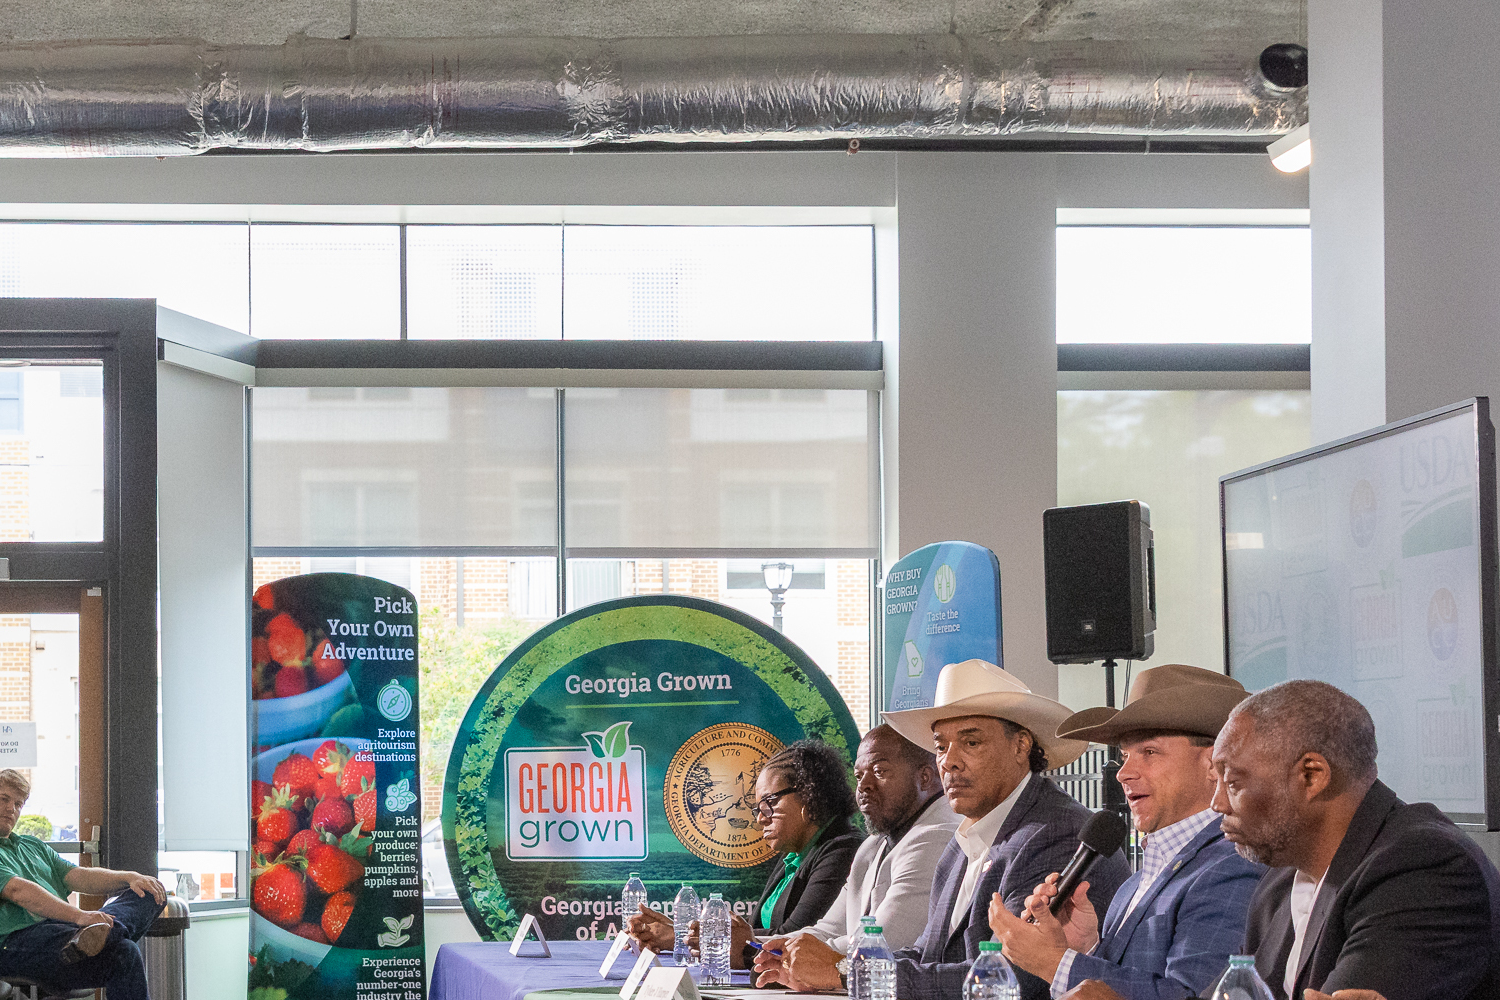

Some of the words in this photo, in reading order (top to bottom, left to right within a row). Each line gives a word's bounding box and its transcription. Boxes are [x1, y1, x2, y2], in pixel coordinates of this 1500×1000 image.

[1399, 433, 1471, 493] USDA
[887, 571, 905, 583] WHY
[906, 568, 921, 580] BUY
[887, 585, 918, 599] GEORGIA
[374, 597, 414, 614] Pick
[886, 601, 918, 614] GROWN?
[927, 611, 946, 622] Taste
[947, 608, 959, 619] the
[327, 619, 369, 637] Your
[374, 621, 414, 637] Own
[926, 622, 960, 635] difference
[321, 643, 415, 661] Adventure
[565, 672, 651, 698] Georgia
[657, 671, 733, 692] Grown
[902, 685, 921, 696] Bring
[378, 728, 416, 740] Explore
[358, 739, 416, 751] agritourism
[355, 752, 416, 762] destinations
[673, 730, 725, 781] AGRICULTURE
[726, 730, 747, 739] AND
[749, 732, 779, 755] COMM
[721, 748, 741, 757] 1776
[519, 762, 633, 814] GEORGIA
[395, 816, 418, 826] Pick
[670, 791, 689, 837] GEORGIA
[688, 834, 750, 861] DEPARTMENT
[751, 844, 765, 857] OF
[371, 829, 395, 840] your
[396, 829, 418, 838] own
[519, 819, 634, 848] grown
[727, 833, 748, 842] 1874
[375, 839, 418, 851] produce:
[380, 852, 419, 863] berries,
[364, 864, 419, 876] pumpkins,
[364, 876, 398, 887] apples
[400, 875, 419, 885] and
[392, 889, 419, 898] more
[541, 895, 623, 920] Georgia
[576, 921, 598, 940] of
[362, 957, 421, 968] Experience
[373, 968, 421, 980] Georgia's
[356, 980, 421, 990] number-one
[403, 990, 421, 1000] the
